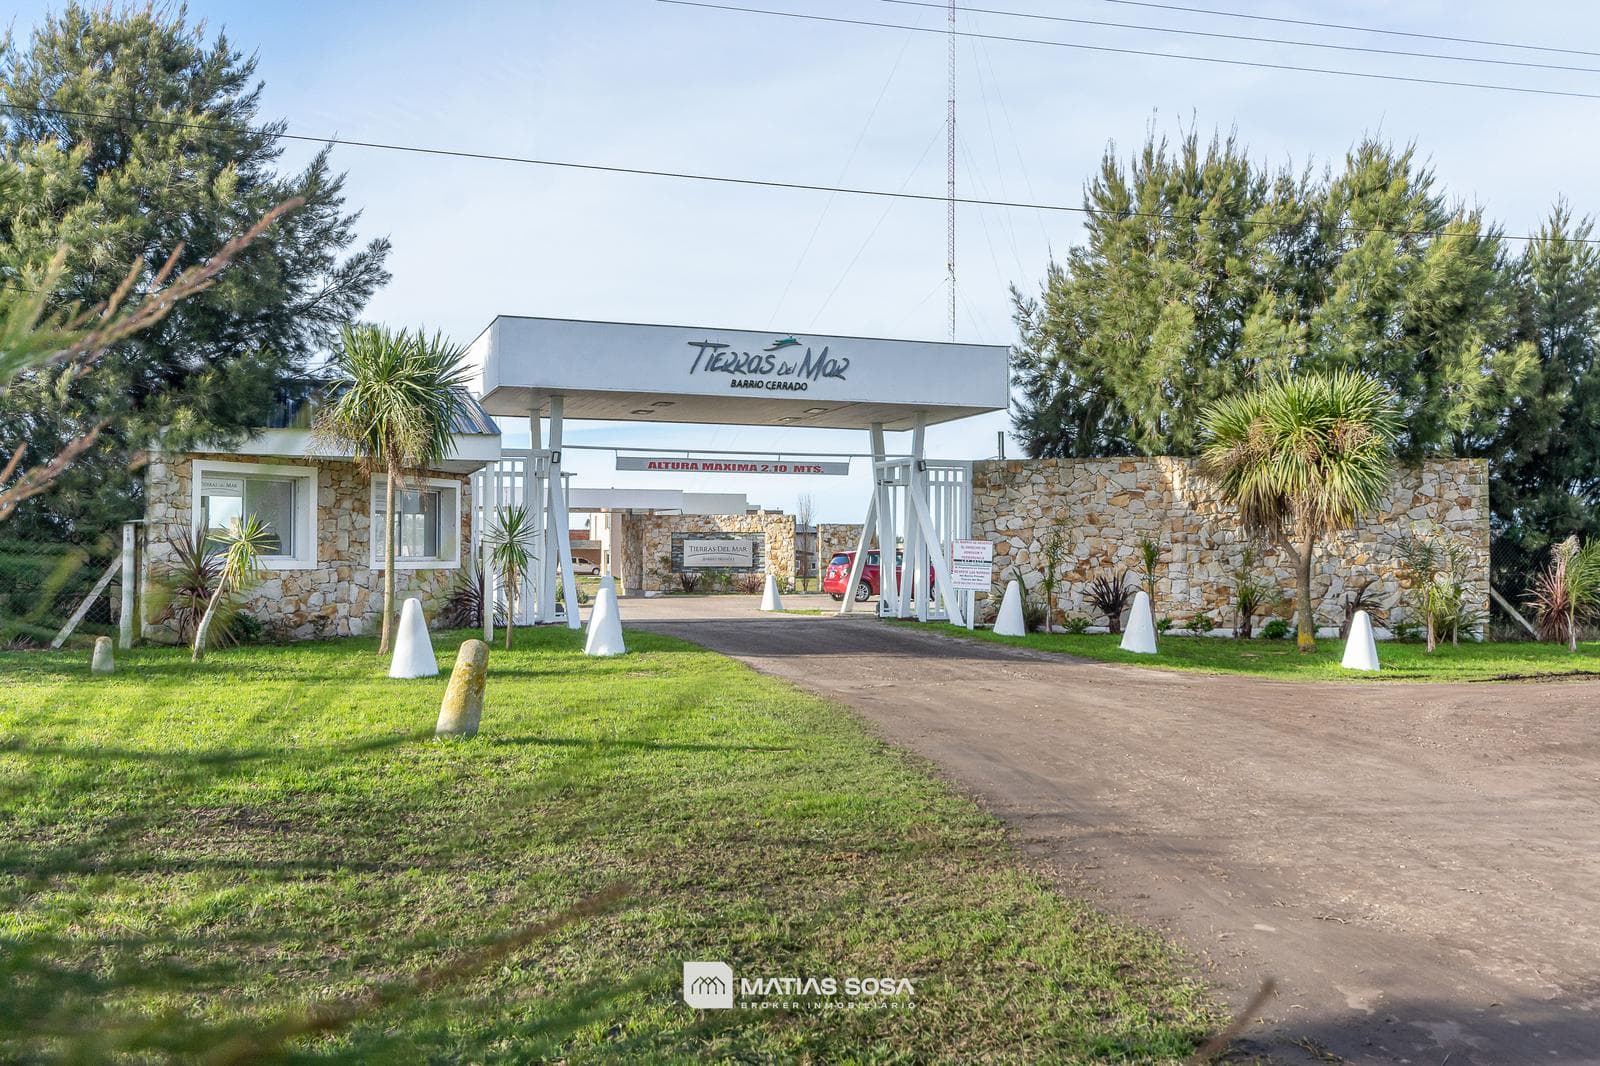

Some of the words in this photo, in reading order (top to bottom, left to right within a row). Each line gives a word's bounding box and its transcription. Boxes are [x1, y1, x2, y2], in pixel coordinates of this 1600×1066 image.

[730, 379, 764, 389] BARRIO
[765, 381, 808, 391] CERRADO
[648, 461, 699, 470] ALTURA
[702, 463, 757, 472] MAXIMA
[761, 464, 788, 473] 2.10
[793, 465, 824, 474] MTS.
